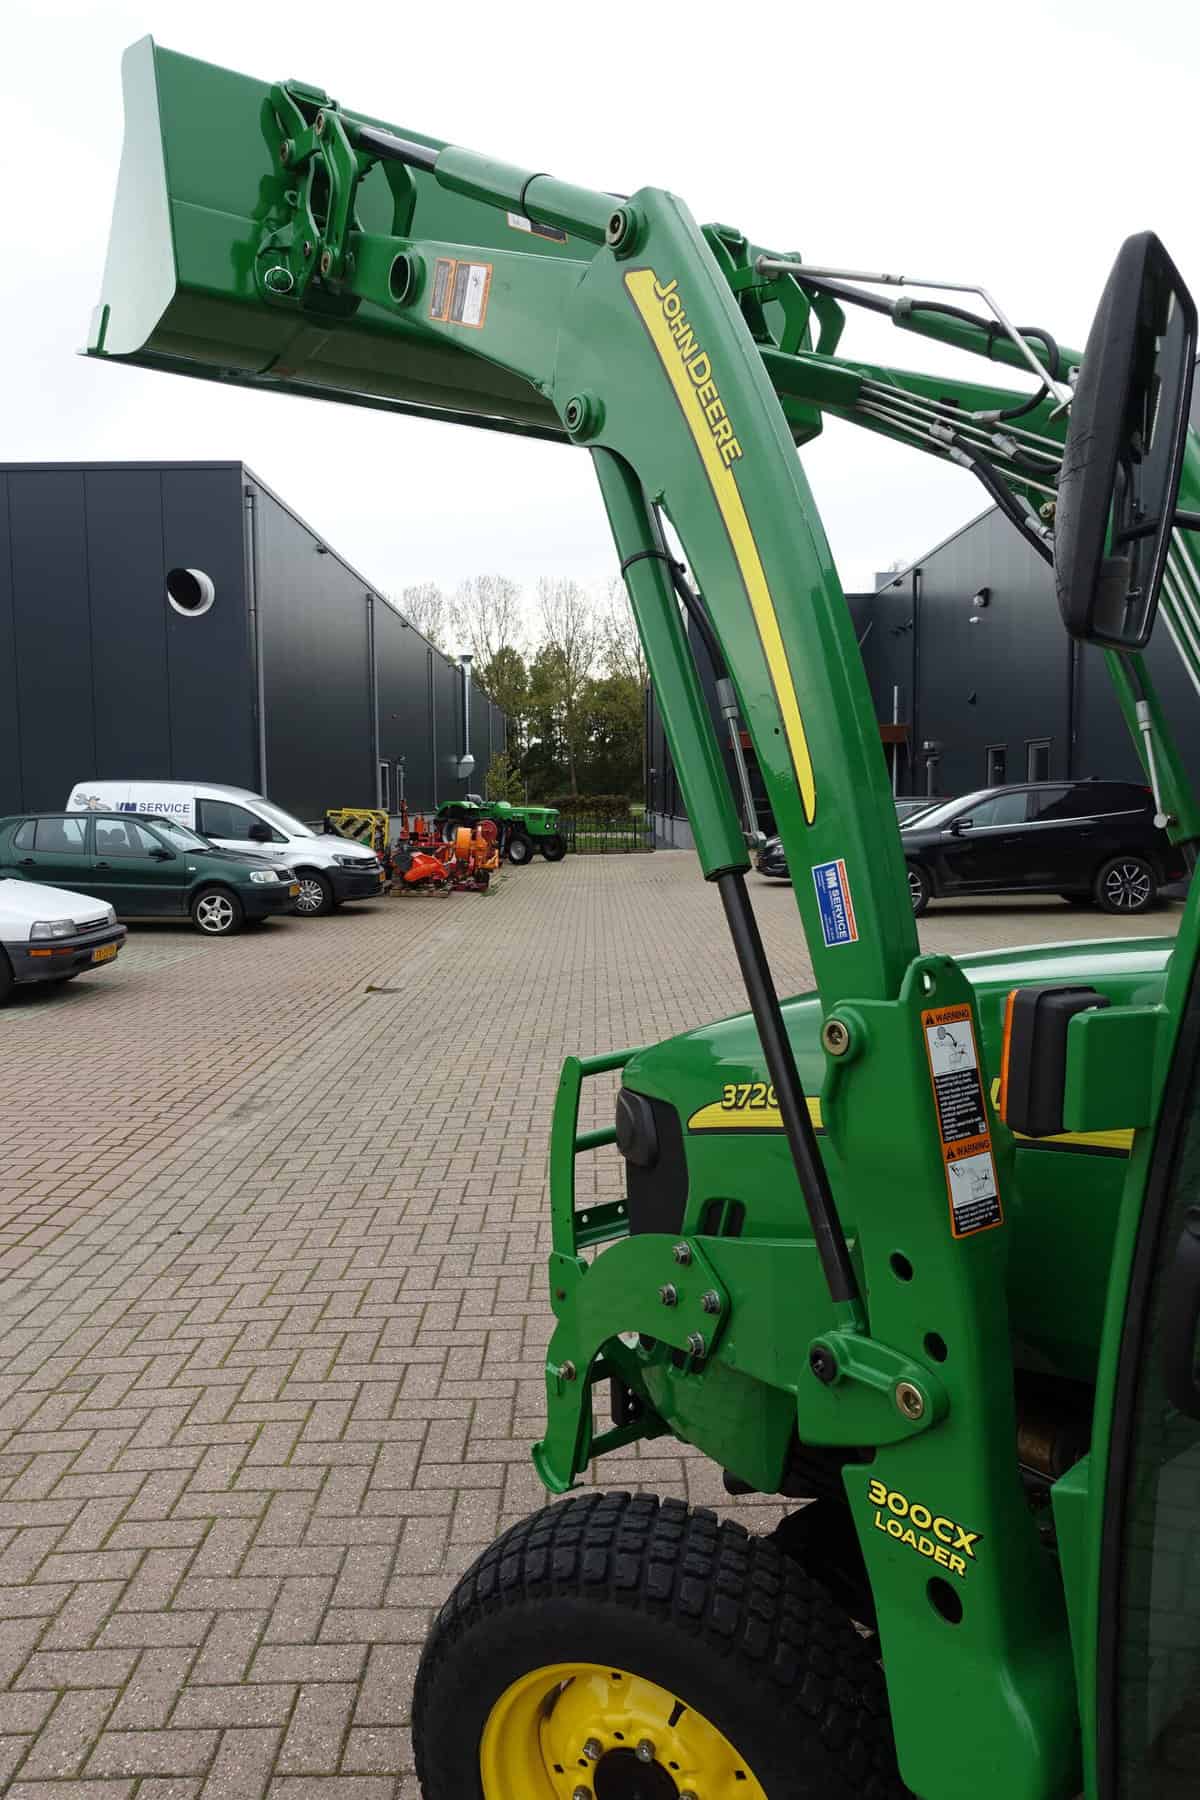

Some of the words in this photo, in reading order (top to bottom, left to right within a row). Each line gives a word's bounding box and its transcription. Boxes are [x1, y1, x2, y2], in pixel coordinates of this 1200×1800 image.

[139, 802, 191, 813] SERVICE
[831, 888, 848, 938] SERVICE
[935, 1009, 969, 1024] WARNING
[868, 1479, 979, 1558] 300CX
[875, 1511, 967, 1577] LOADER
